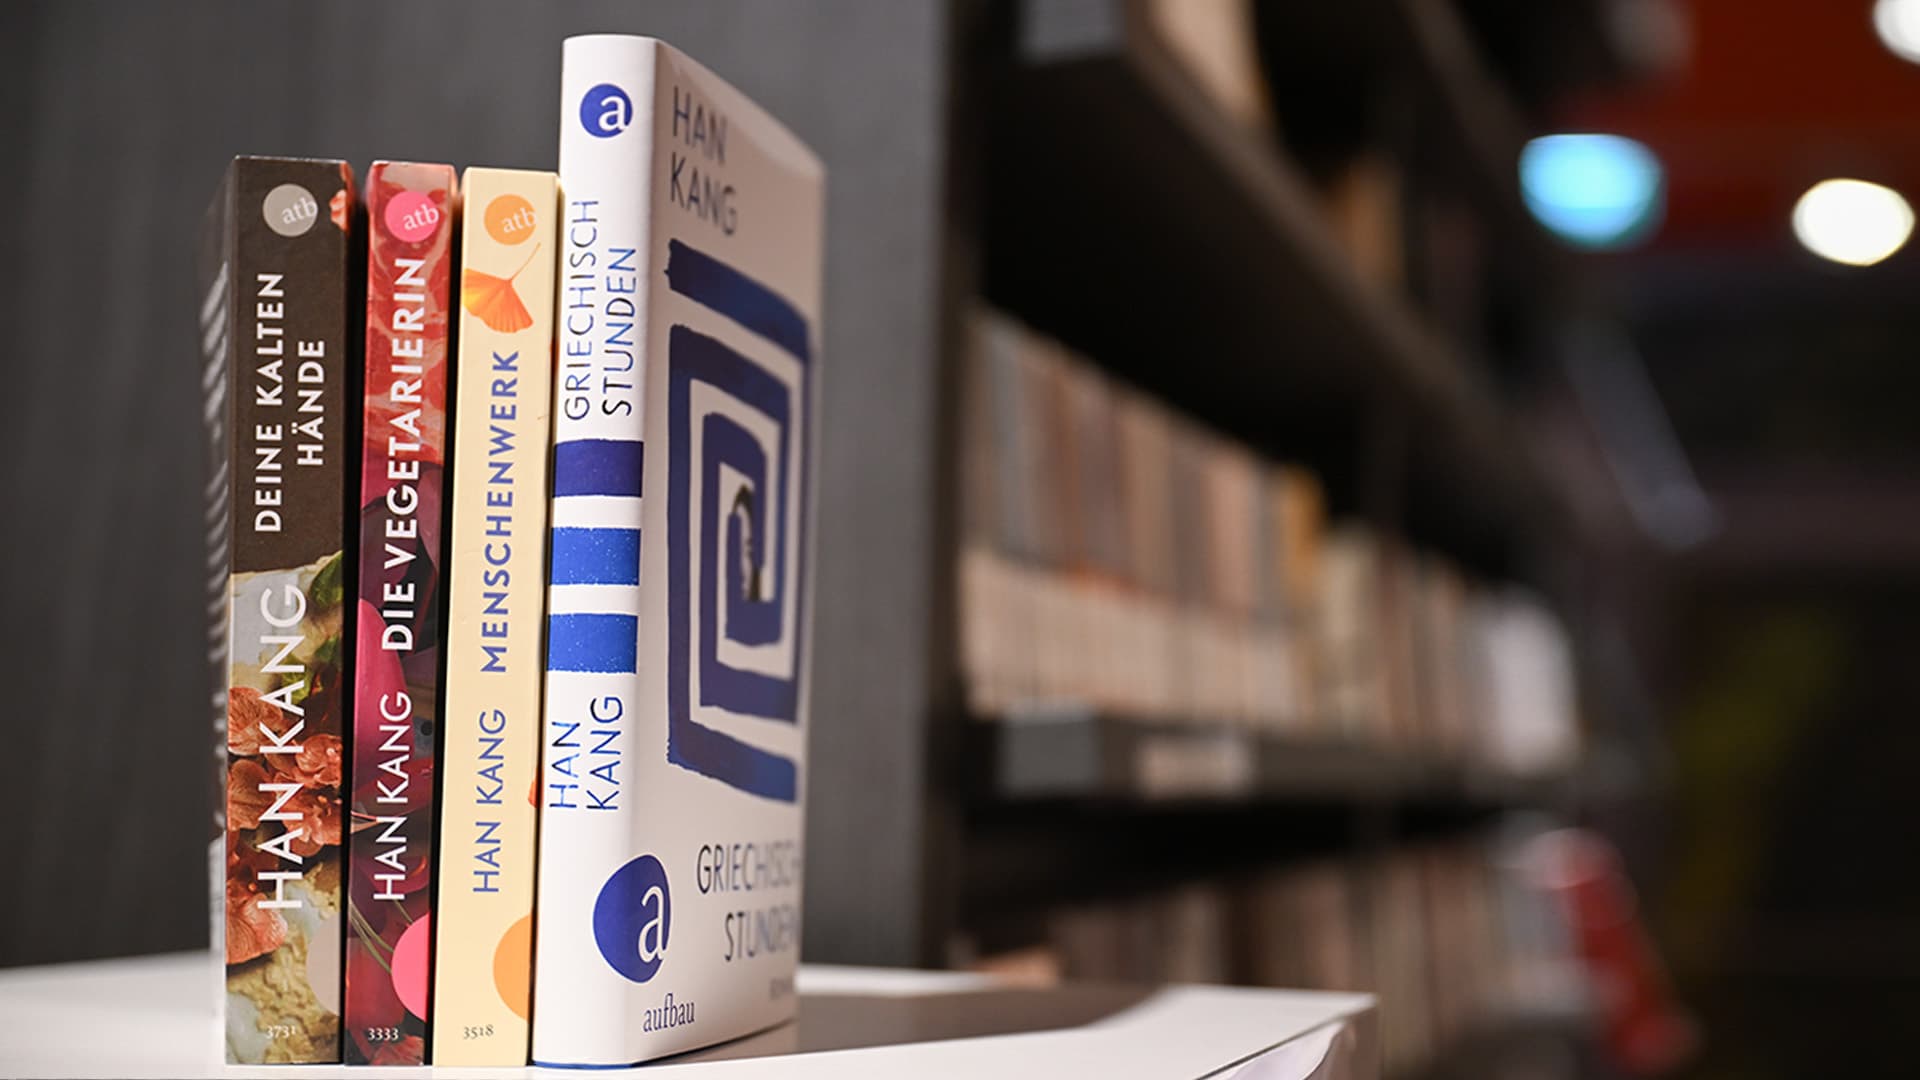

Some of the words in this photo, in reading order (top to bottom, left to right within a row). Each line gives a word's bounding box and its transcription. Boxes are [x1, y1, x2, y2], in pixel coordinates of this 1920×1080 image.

[672, 85, 727, 166] HAN
[281, 198, 319, 225] atb
[403, 204, 440, 232] atb
[502, 209, 537, 234] atb
[669, 152, 737, 236] KANG
[256, 273, 285, 406] KALTEN
[564, 200, 599, 421] GRIECHISCH
[602, 247, 637, 417] STUNDEN
[292, 340, 325, 466] HÄNDE
[383, 258, 426, 570] VEGETARIERIN
[255, 424, 282, 533] DEINE
[481, 350, 519, 673] MENSCHENWERK
[381, 583, 415, 651] DIE
[259, 583, 307, 754] KANG
[377, 691, 413, 805] KANG
[475, 708, 506, 805] KANG
[549, 720, 581, 810] HAN
[586, 695, 624, 811] KANG
[257, 782, 304, 909] HAN
[373, 816, 409, 901] HAN
[472, 821, 502, 893] HAN
[265, 1025, 298, 1040] 3731
[367, 1027, 399, 1041] 3333
[463, 1023, 495, 1040] 3518
[642, 993, 696, 1033] aufbau
